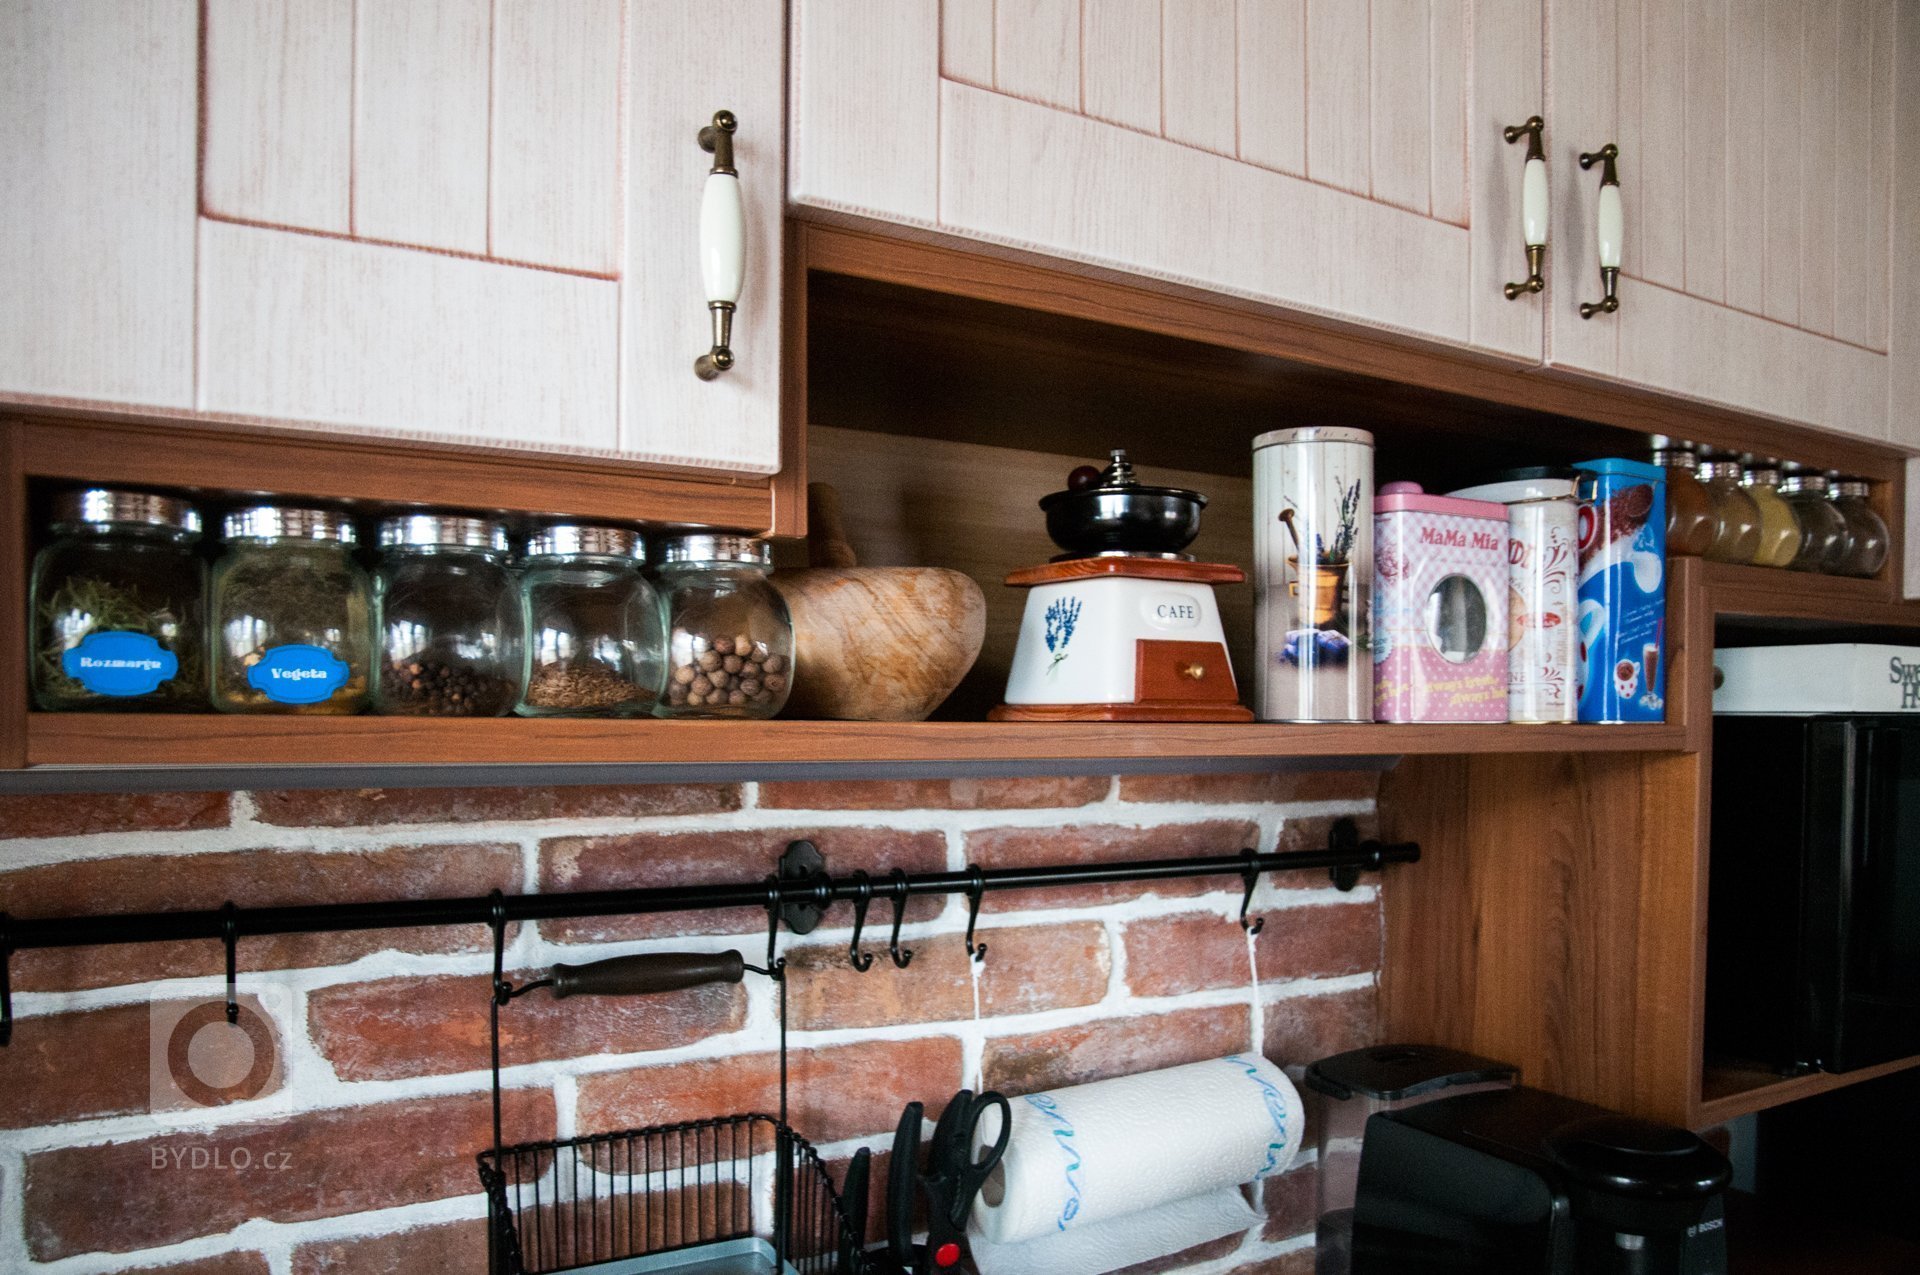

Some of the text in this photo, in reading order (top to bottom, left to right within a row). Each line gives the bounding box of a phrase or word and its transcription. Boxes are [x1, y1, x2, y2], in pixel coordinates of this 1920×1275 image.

[1419, 526, 1499, 551] MaMa Mia
[1157, 604, 1195, 619] CAFE
[270, 667, 328, 682] Vegeta
[1698, 1217, 1723, 1233] BOSCH
